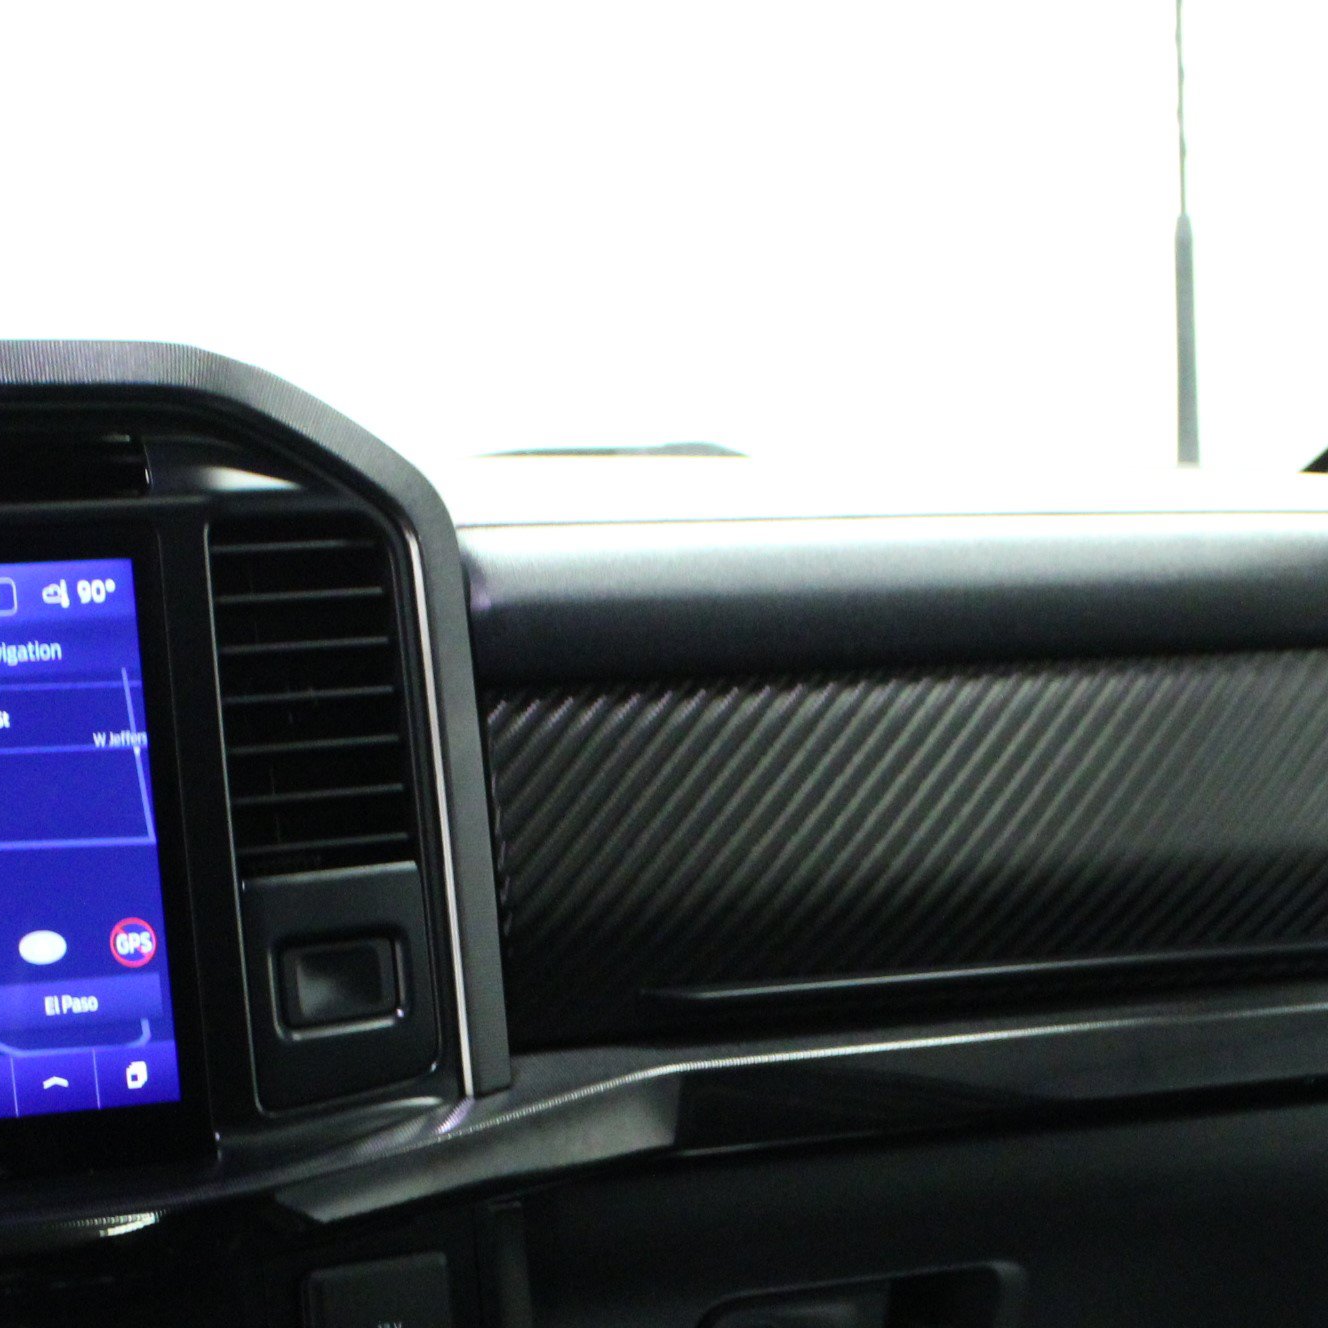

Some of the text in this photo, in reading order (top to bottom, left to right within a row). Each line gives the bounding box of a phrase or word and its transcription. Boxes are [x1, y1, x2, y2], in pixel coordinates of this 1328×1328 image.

[92, 732, 106, 748] W
[116, 932, 152, 955] GPS
[44, 995, 98, 1016] El Paso
